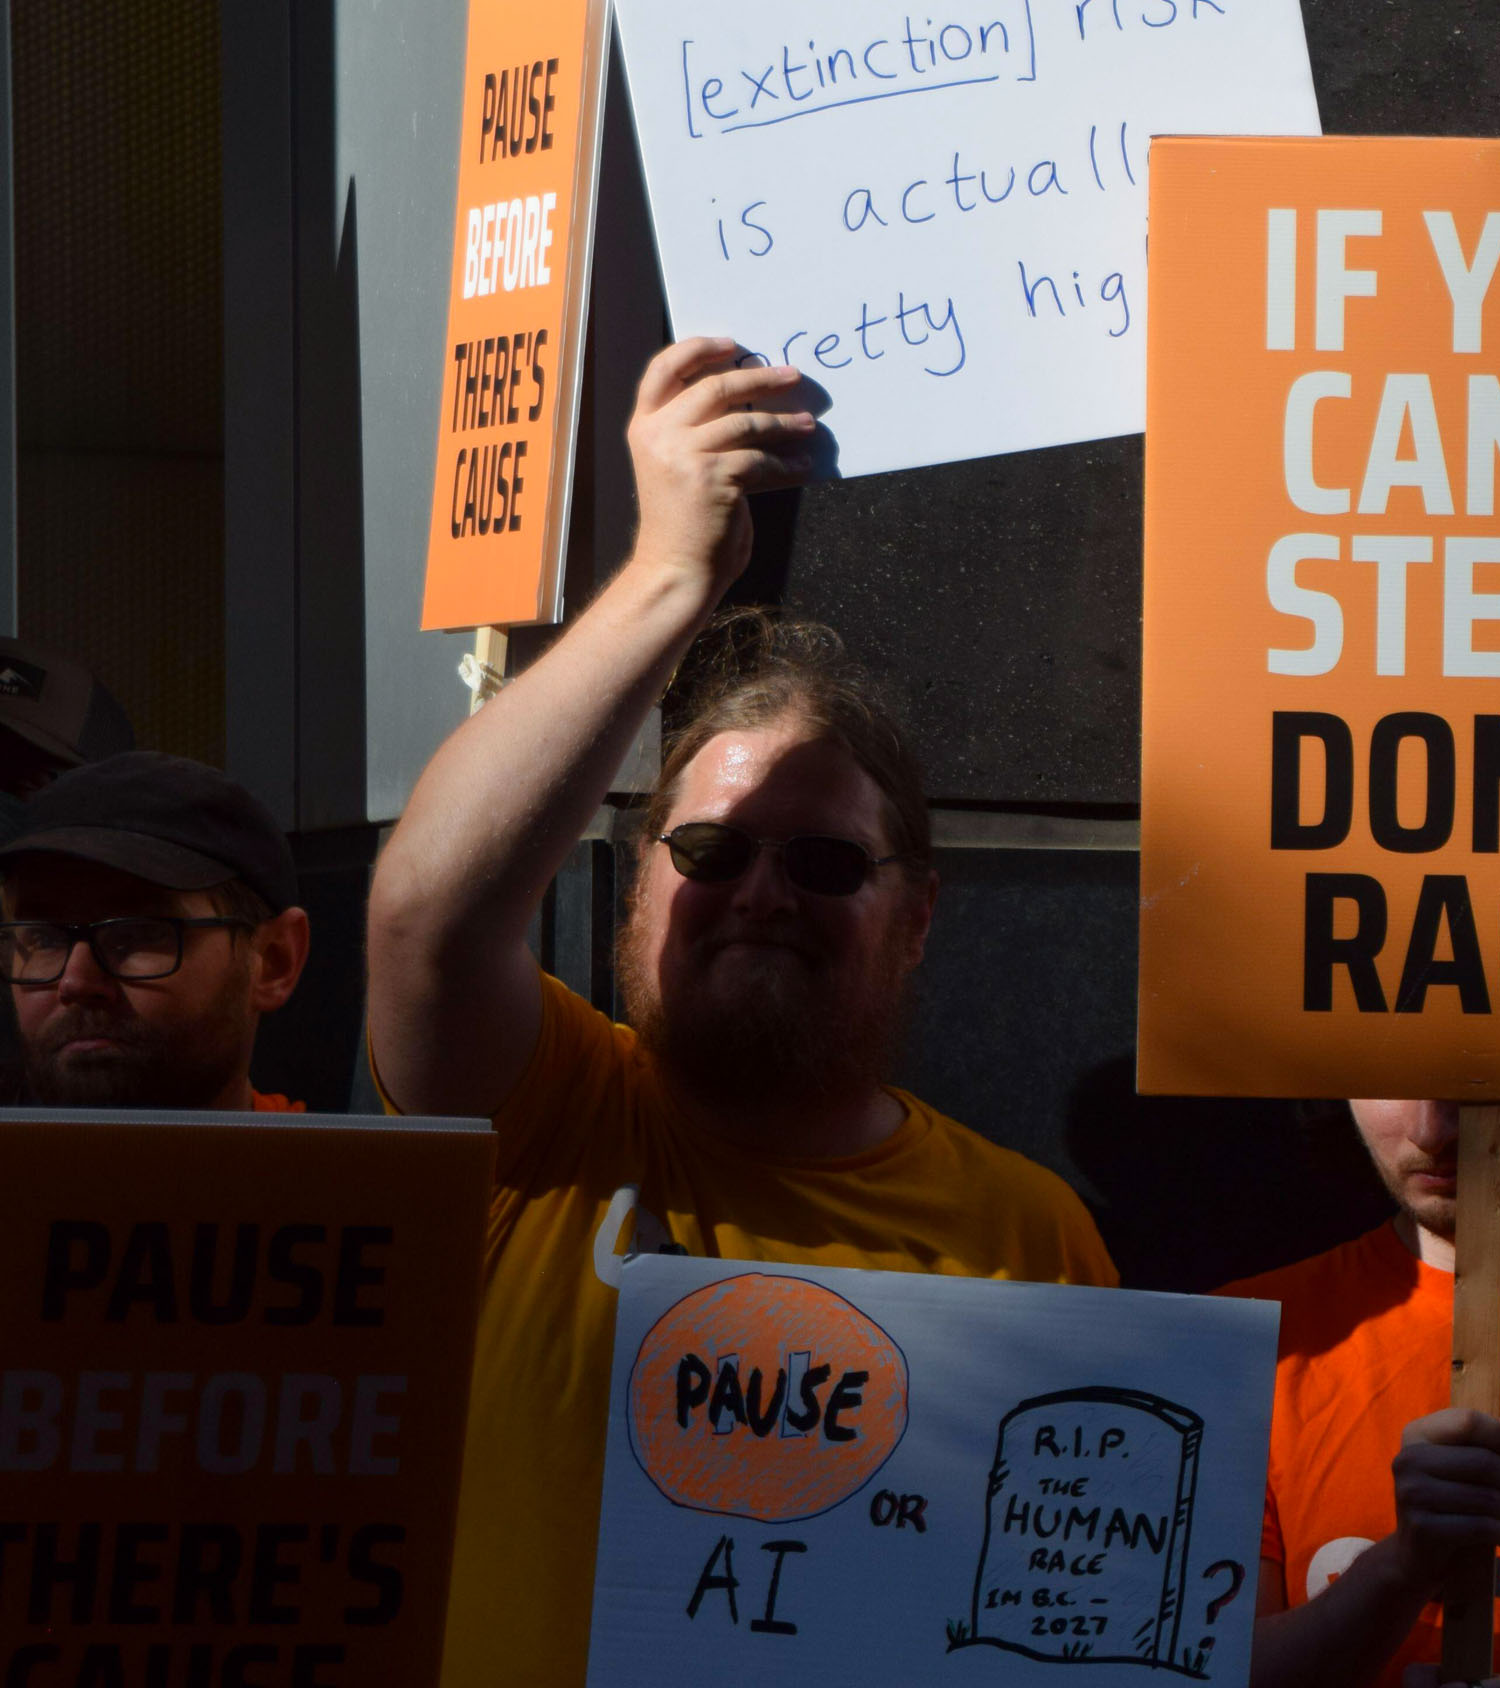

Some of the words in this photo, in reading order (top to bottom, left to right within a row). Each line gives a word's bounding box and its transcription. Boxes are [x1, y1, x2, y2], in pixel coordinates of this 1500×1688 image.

[479, 58, 559, 165] PAUSE
[683, 0, 1036, 138] [extinction]
[712, 198, 773, 260] is
[843, 122, 1140, 231] actuall
[463, 192, 557, 300] BEFORE
[1266, 208, 1383, 351] IF
[1018, 261, 1134, 337] hig
[452, 329, 548, 433] THERE'S
[451, 440, 528, 539] CAUSE
[42, 1221, 394, 1327] PAUSE
[0, 1370, 408, 1476] BEFORE
[677, 1354, 869, 1441] PAUSE
[1035, 1425, 1129, 1458] R.I.P.
[870, 1489, 928, 1533] OR
[1003, 1493, 1168, 1554] HUMAN
[1039, 1476, 1090, 1498] THE
[686, 1535, 807, 1635] AI
[1028, 1547, 1107, 1576] RACE
[1202, 1559, 1245, 1650] ?
[1031, 1615, 1109, 1636] 2027
